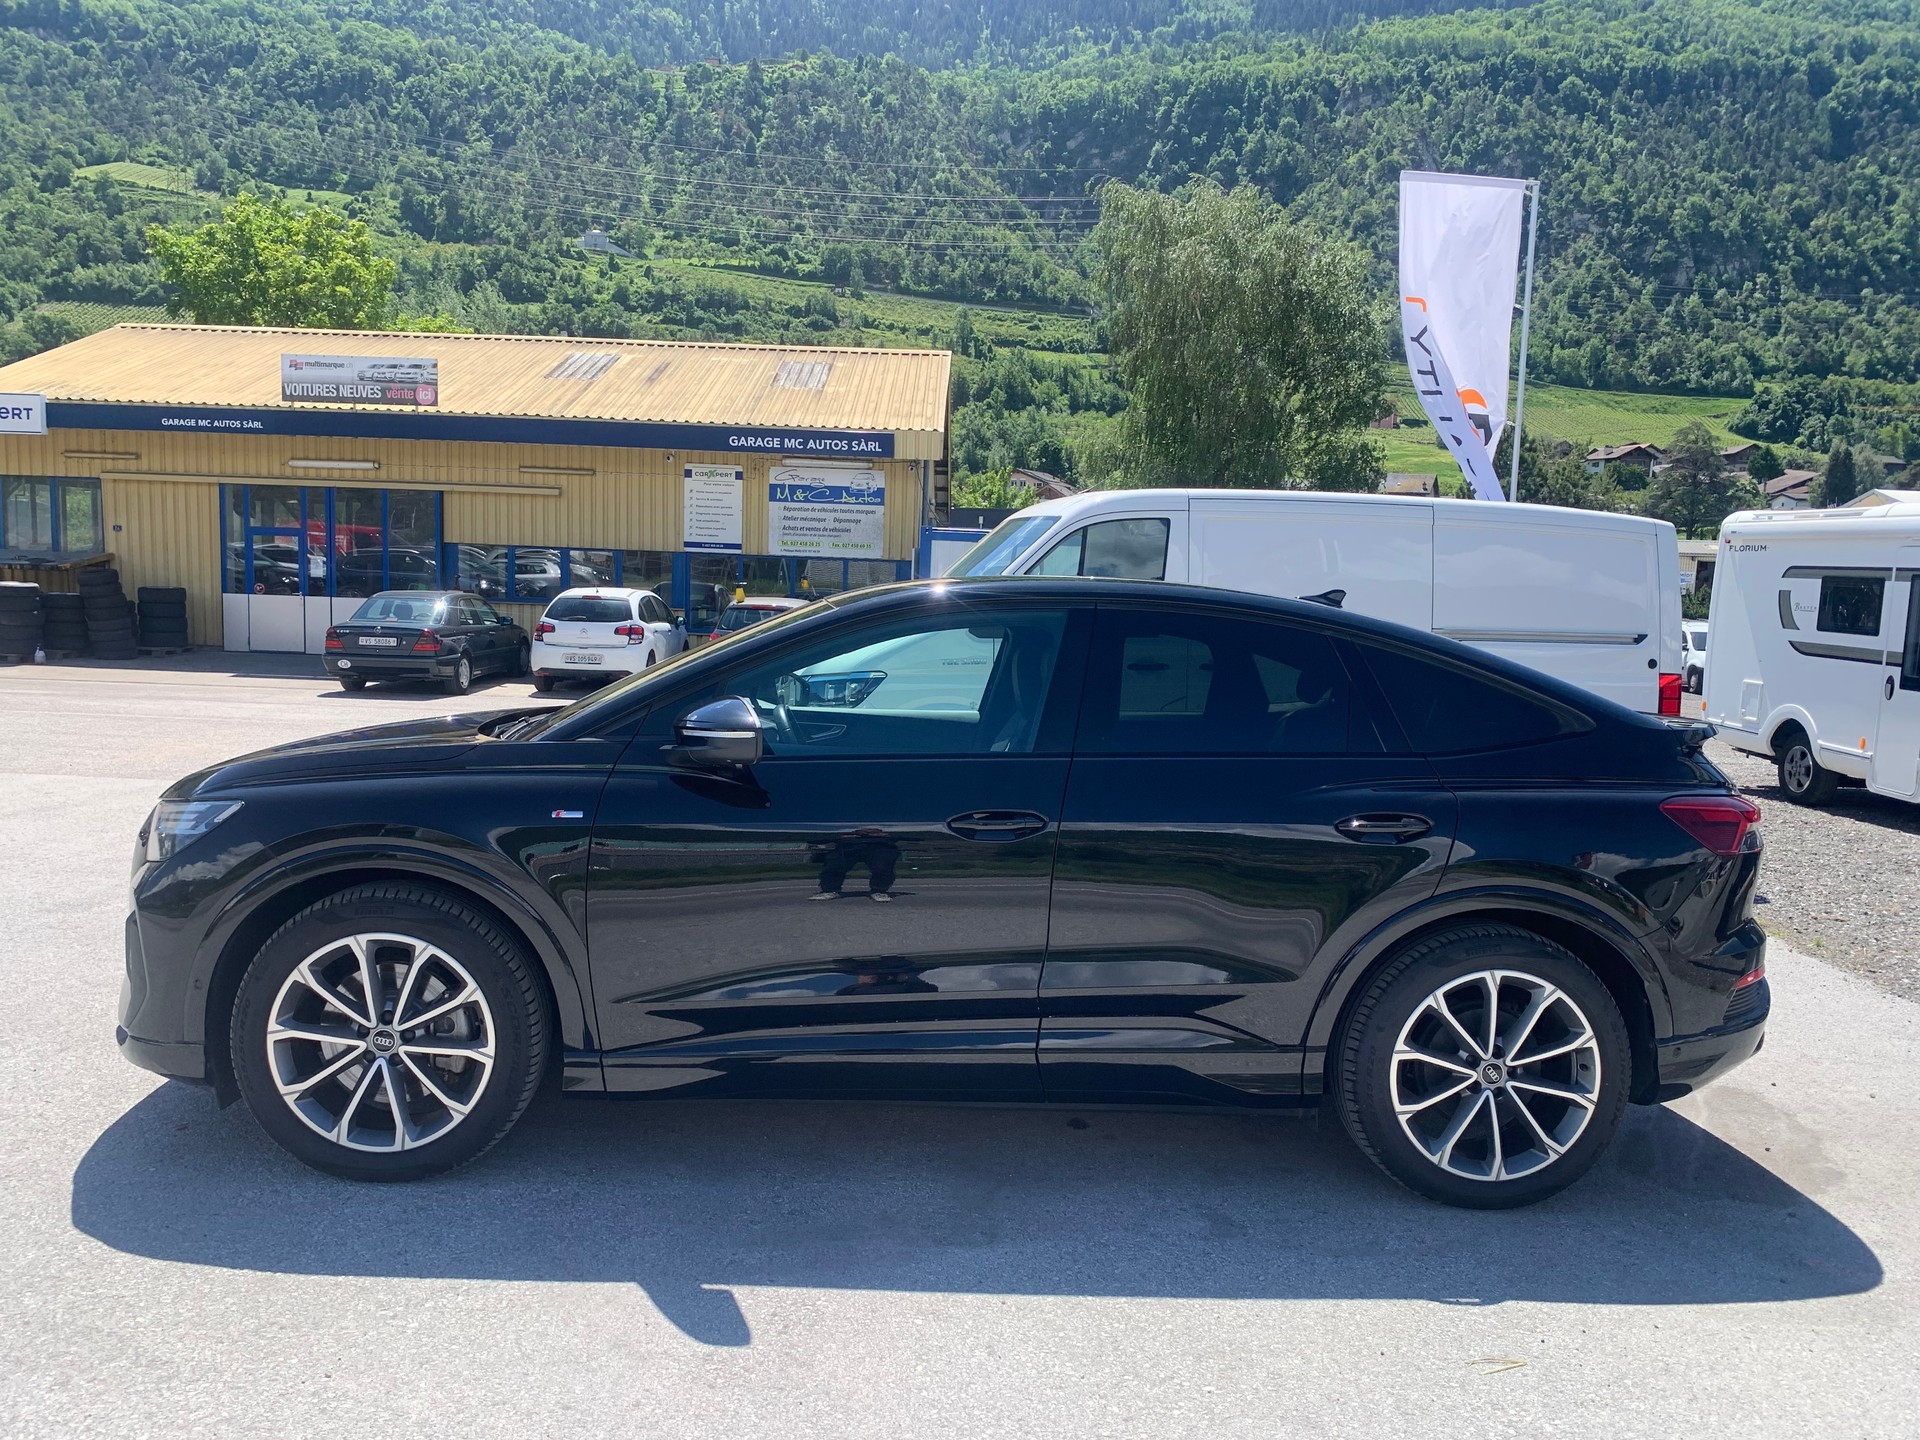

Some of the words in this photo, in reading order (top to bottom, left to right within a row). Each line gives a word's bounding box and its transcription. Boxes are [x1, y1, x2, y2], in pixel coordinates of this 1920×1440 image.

[284, 383, 337, 397] VOITURES
[339, 384, 381, 398] NEUVES
[386, 388, 414, 399] vente
[419, 387, 432, 400] ici
[161, 418, 196, 427] GARAGE
[198, 419, 212, 427] MC
[213, 420, 241, 428] AUTOS
[243, 418, 263, 429] SÀRL
[729, 435, 781, 448] GARAGE
[784, 438, 804, 449] MC
[806, 439, 849, 451] AUTOS
[851, 438, 882, 452] SÀRL
[774, 468, 825, 488] Garage
[776, 483, 791, 502] M
[793, 488, 809, 501] &
[808, 488, 834, 502] C
[834, 489, 881, 503] Autos
[783, 505, 810, 513] Réparation
[833, 517, 862, 525] Dépannage
[1729, 544, 1767, 552] FLORIUM
